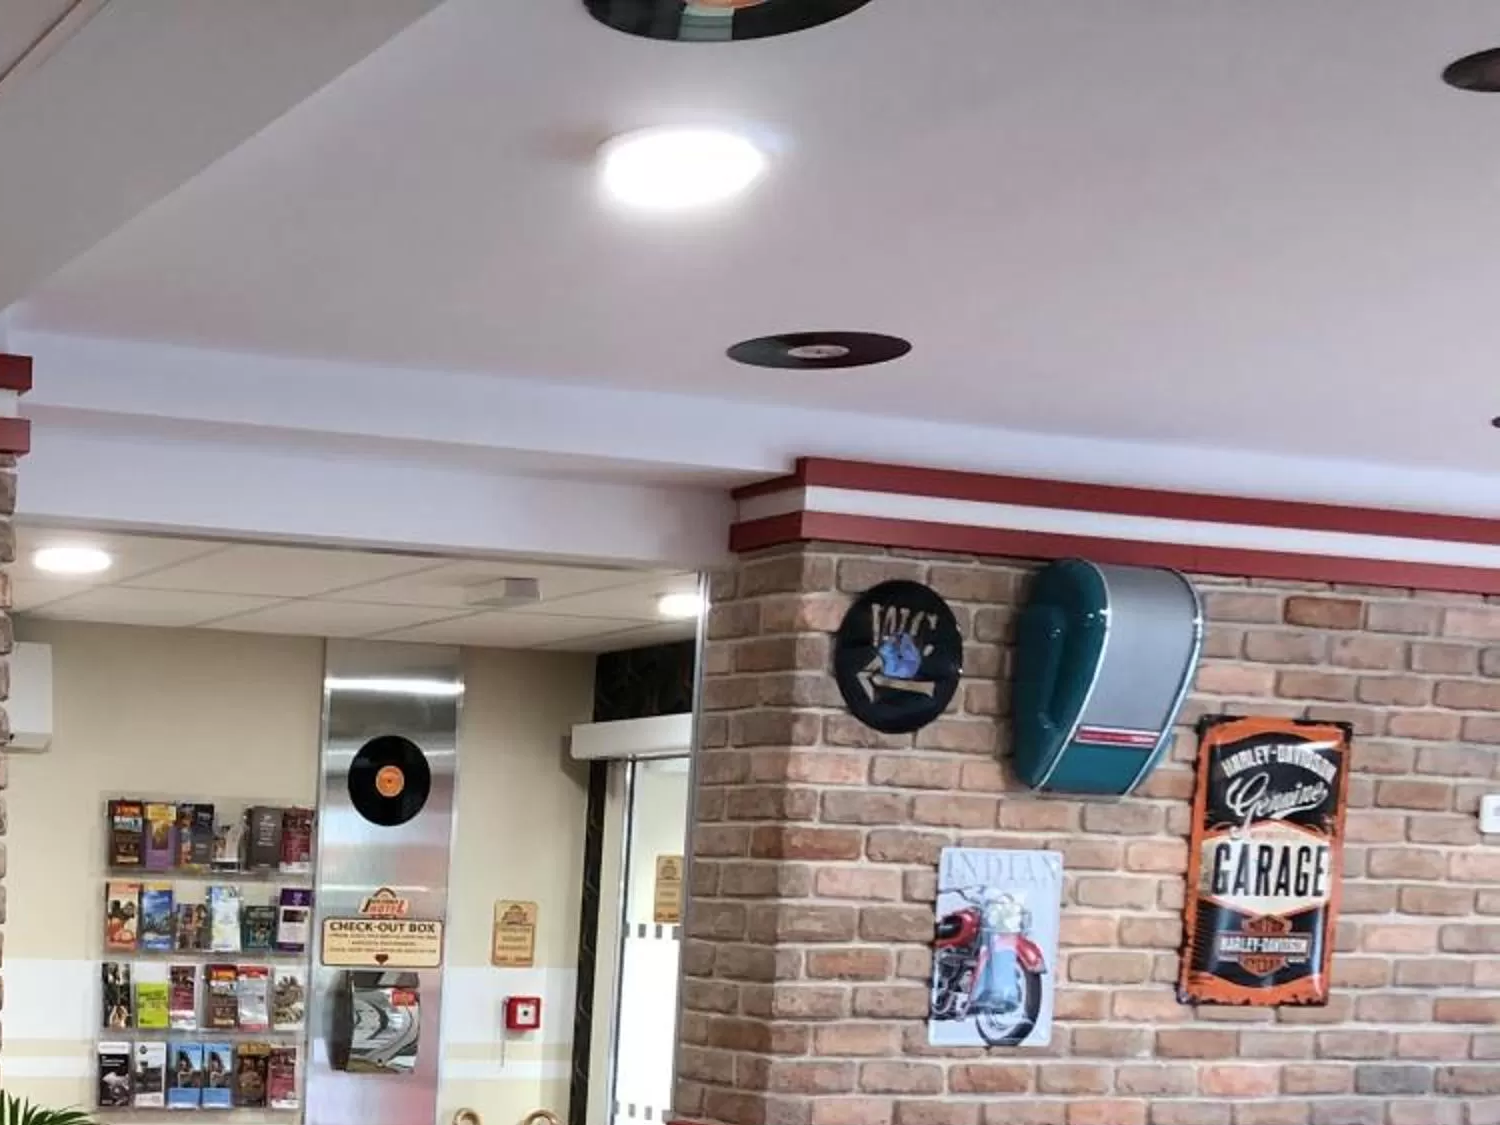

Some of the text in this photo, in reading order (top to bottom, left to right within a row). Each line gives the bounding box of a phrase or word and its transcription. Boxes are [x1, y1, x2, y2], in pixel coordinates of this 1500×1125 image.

[1221, 744, 1338, 785] HARLEY-DAVIDSON
[1225, 771, 1329, 839] Genuine
[946, 851, 1059, 882] INDIAN
[1211, 842, 1327, 898] GARAGE
[329, 921, 435, 933] CHECK-OUT BOX
